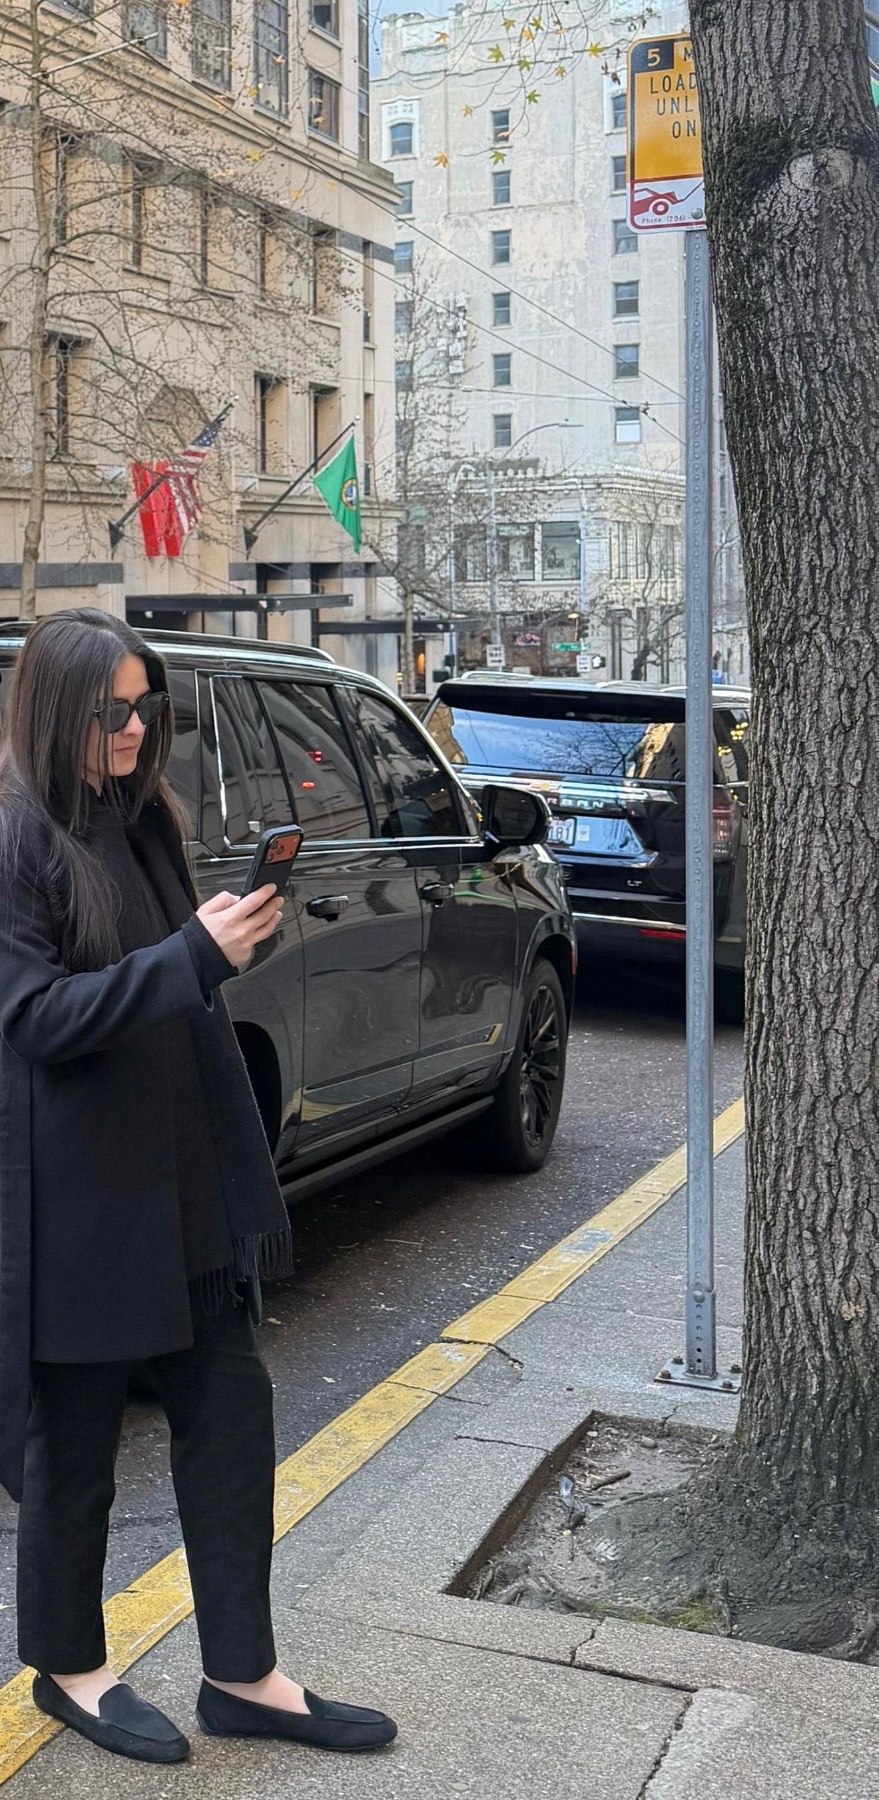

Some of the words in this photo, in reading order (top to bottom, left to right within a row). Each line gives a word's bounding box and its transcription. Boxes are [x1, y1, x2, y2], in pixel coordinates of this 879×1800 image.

[647, 48, 661, 67] 5
[650, 72, 697, 94] LOAD
[657, 95, 694, 116] UNL
[672, 119, 696, 138] ON
